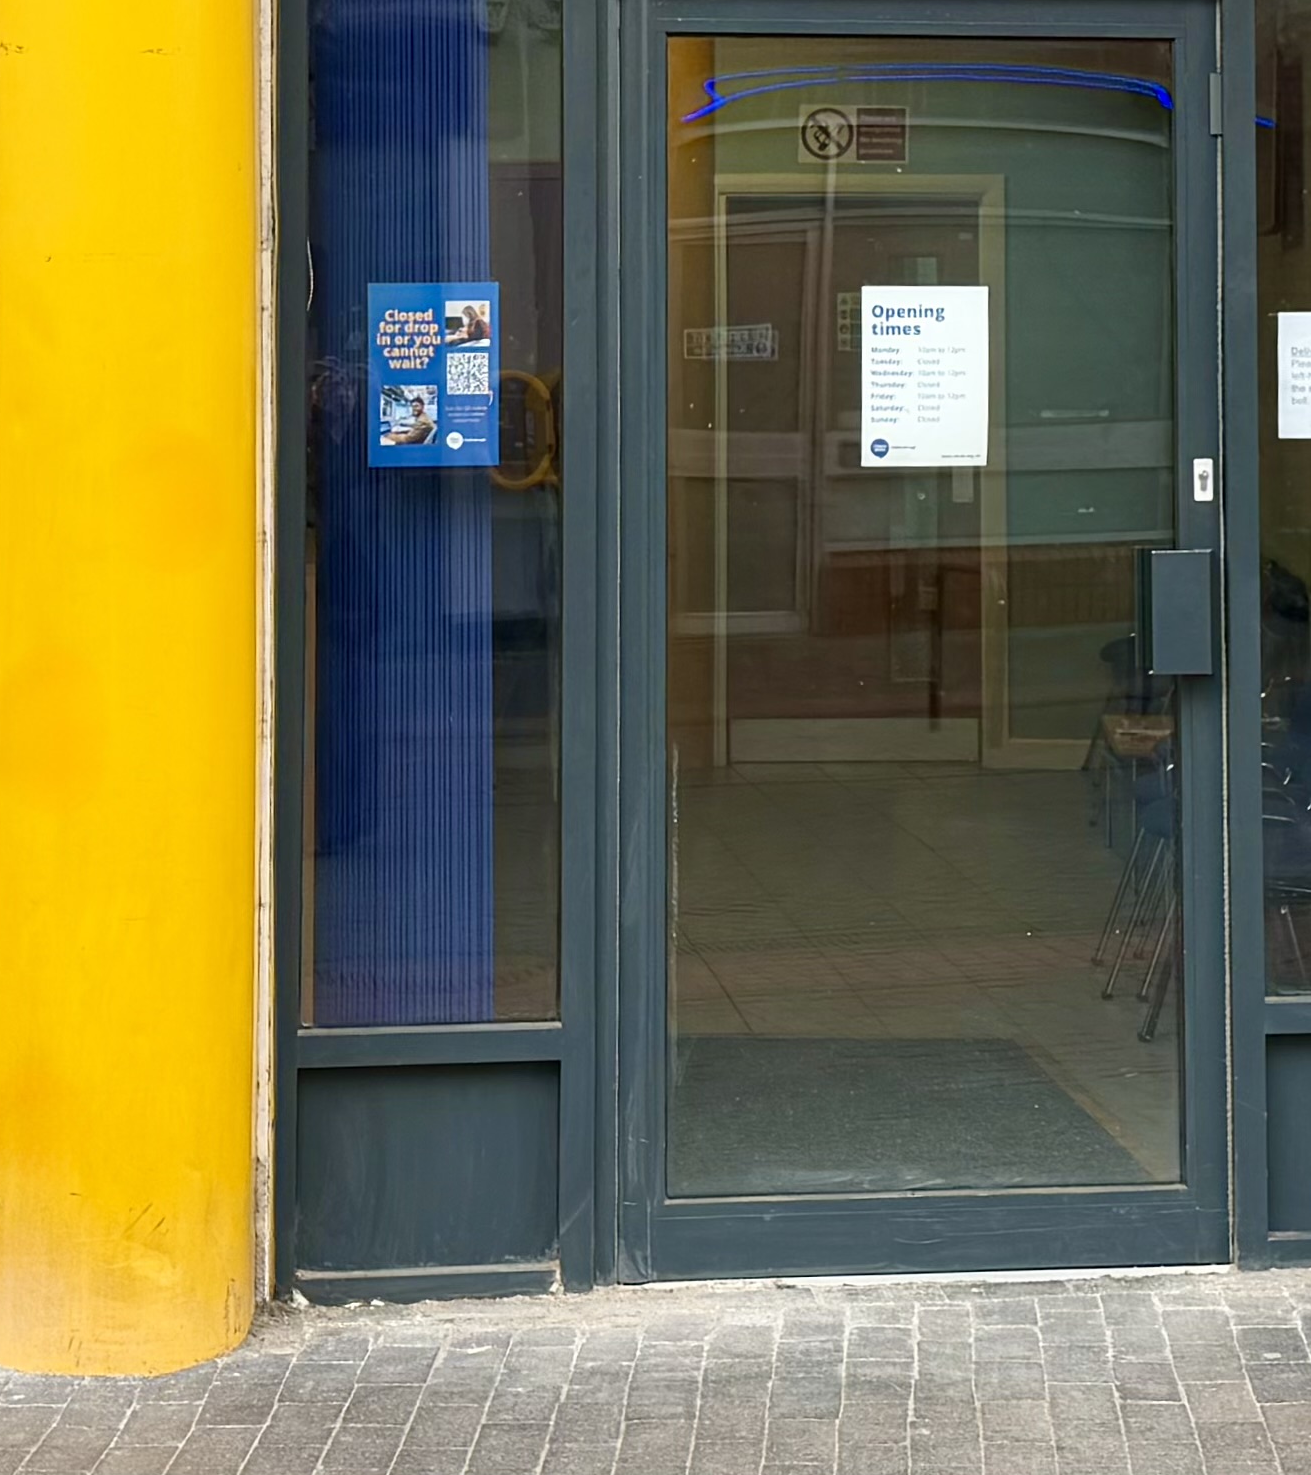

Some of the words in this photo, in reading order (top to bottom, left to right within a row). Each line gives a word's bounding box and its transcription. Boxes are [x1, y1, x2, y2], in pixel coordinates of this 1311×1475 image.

[385, 308, 433, 321] Closed
[871, 304, 945, 322] Opening
[379, 321, 401, 333] for
[404, 321, 439, 336] drop
[871, 322, 922, 336] times
[376, 333, 391, 345] in
[394, 335, 411, 345] or
[413, 335, 441, 348] you
[383, 345, 434, 357] cannot
[388, 356, 429, 369] wait?
[1291, 384, 1306, 393] the
